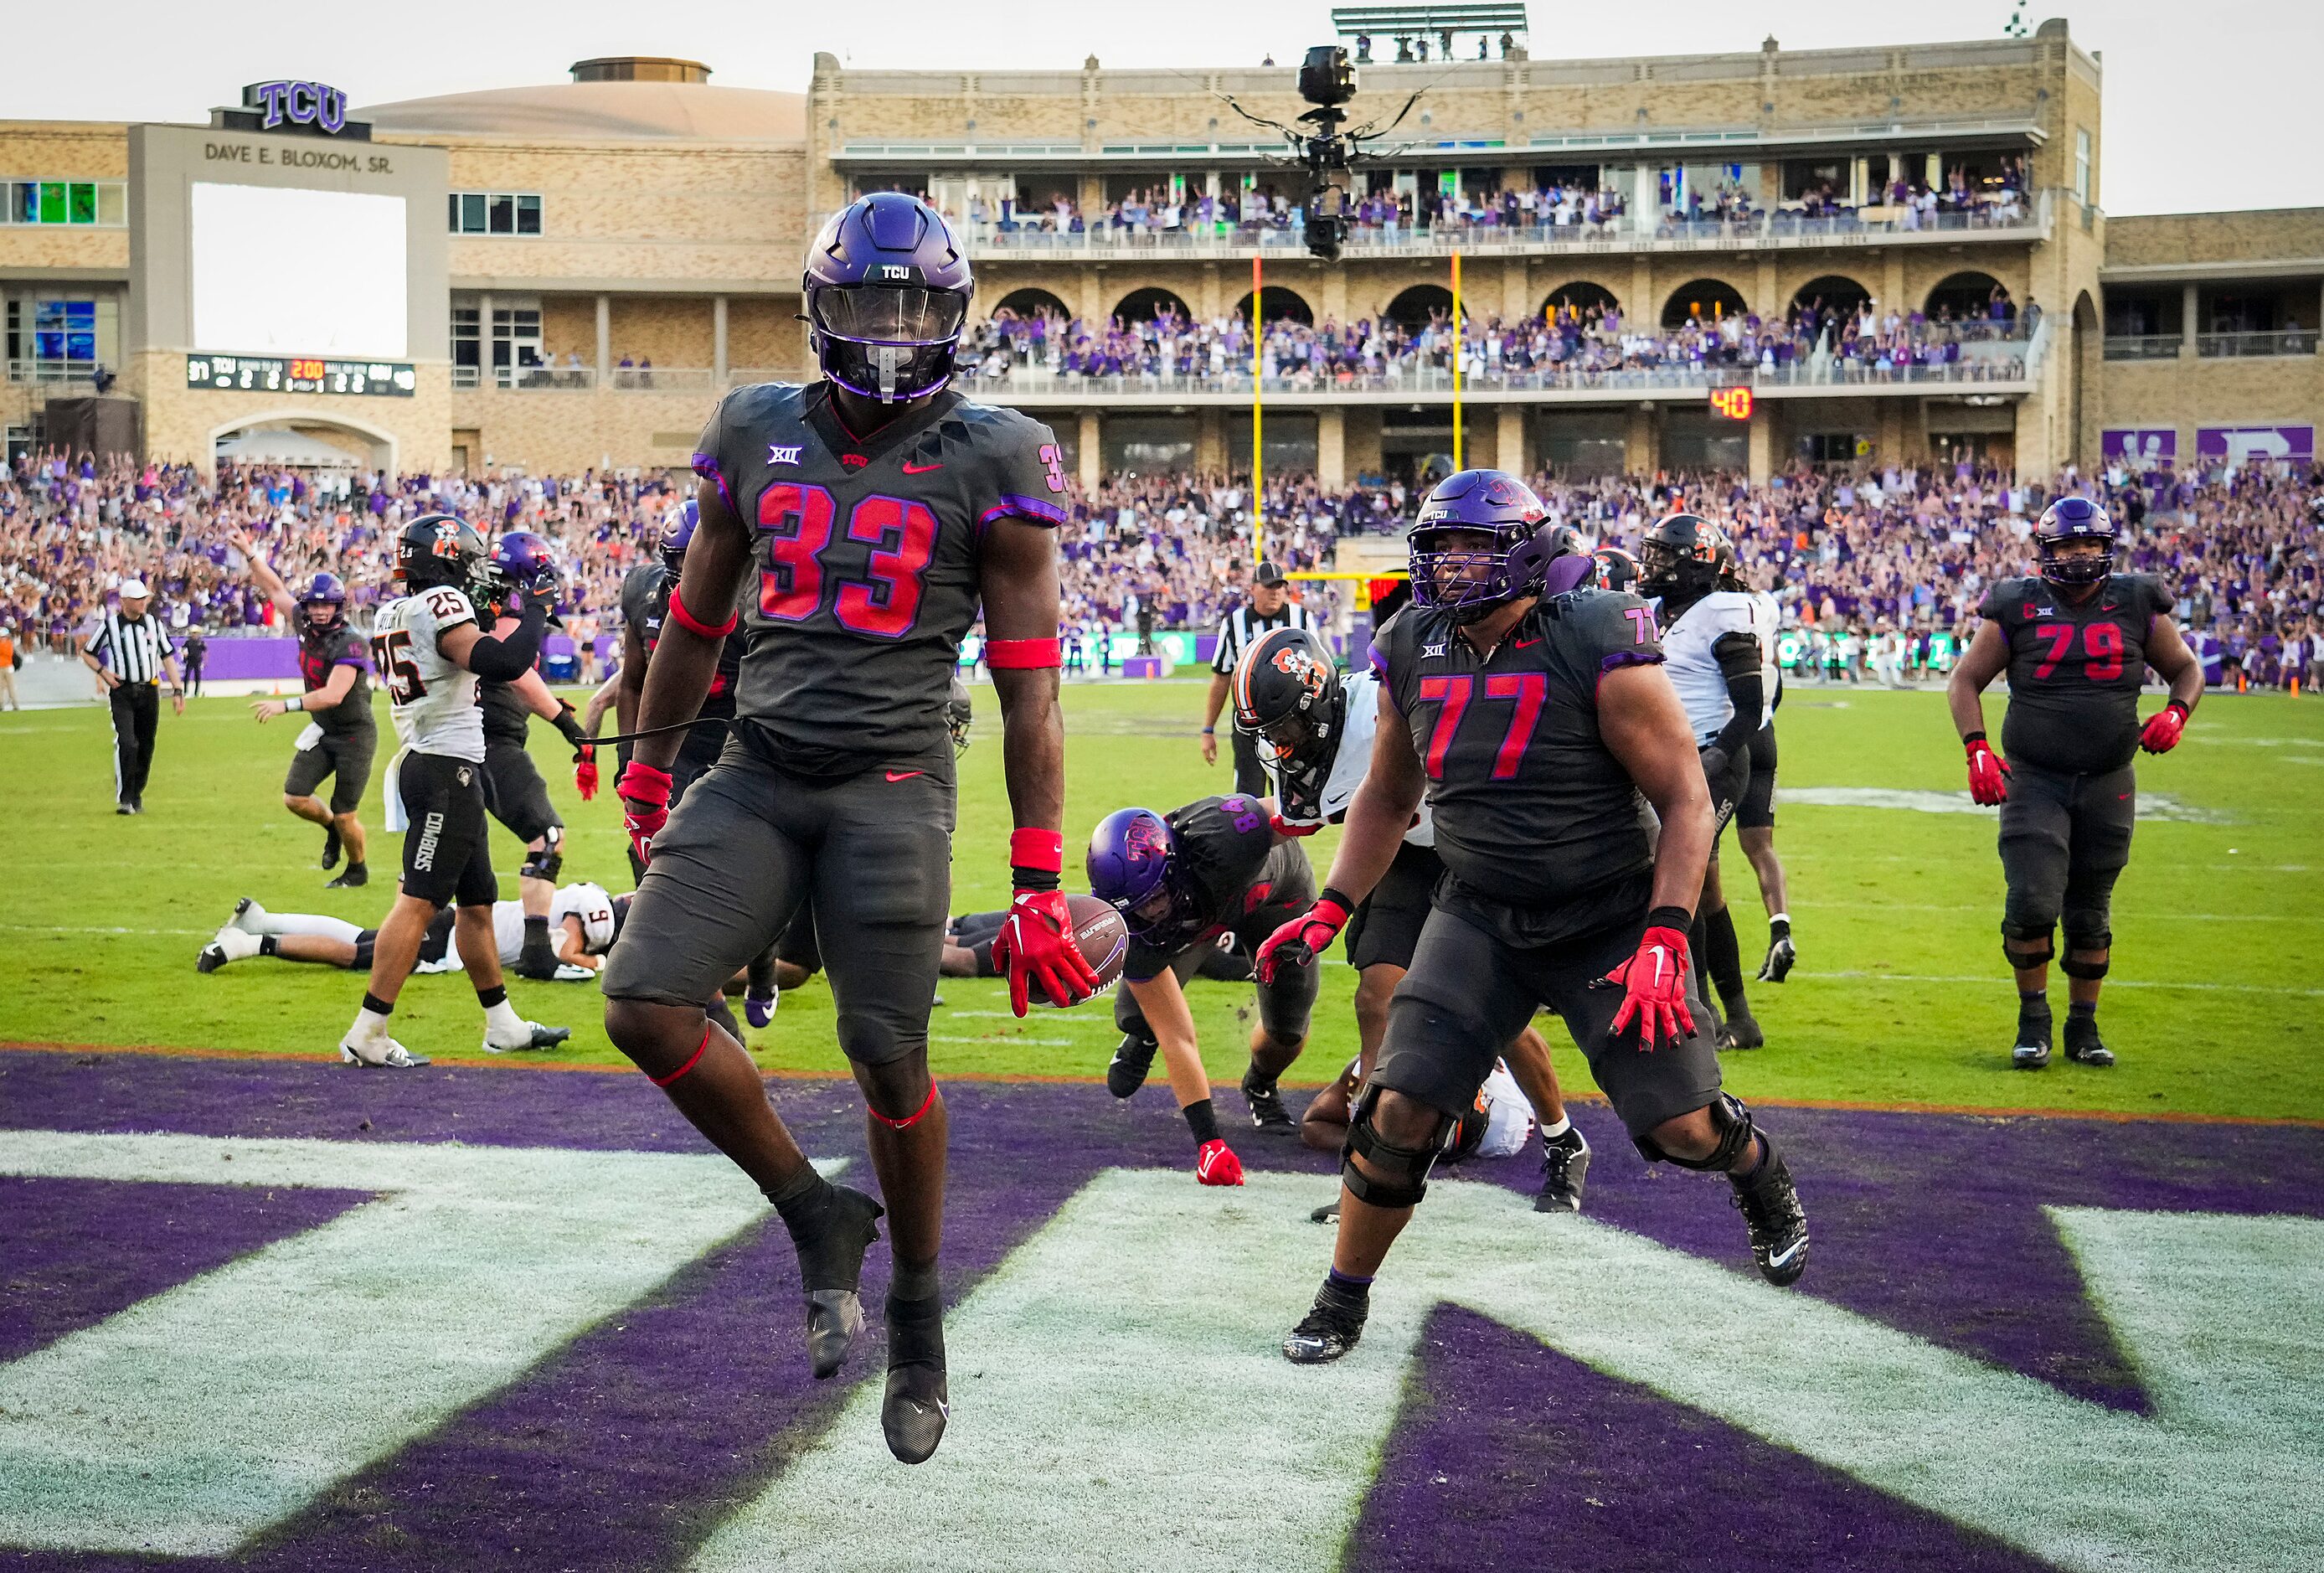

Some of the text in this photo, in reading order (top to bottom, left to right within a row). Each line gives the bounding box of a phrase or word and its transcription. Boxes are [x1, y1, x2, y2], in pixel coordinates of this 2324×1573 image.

[258, 80, 347, 134] TCU
[206, 143, 394, 173] DAVE E. BLOXOM, SR.
[882, 266, 910, 279] TCU
[212, 357, 236, 374] TCU
[1710, 387, 1753, 420] 40
[767, 445, 802, 465] XII
[843, 454, 868, 467] TCU
[1038, 444, 1068, 493] 3
[756, 480, 941, 639] 33
[426, 591, 464, 619] 25
[1623, 607, 1660, 645] 77
[1421, 642, 1446, 659] XII
[2033, 622, 2123, 680] 79
[1420, 672, 1547, 781] 77
[415, 812, 444, 872] COWBOYS
[1126, 817, 1162, 861] TCU
